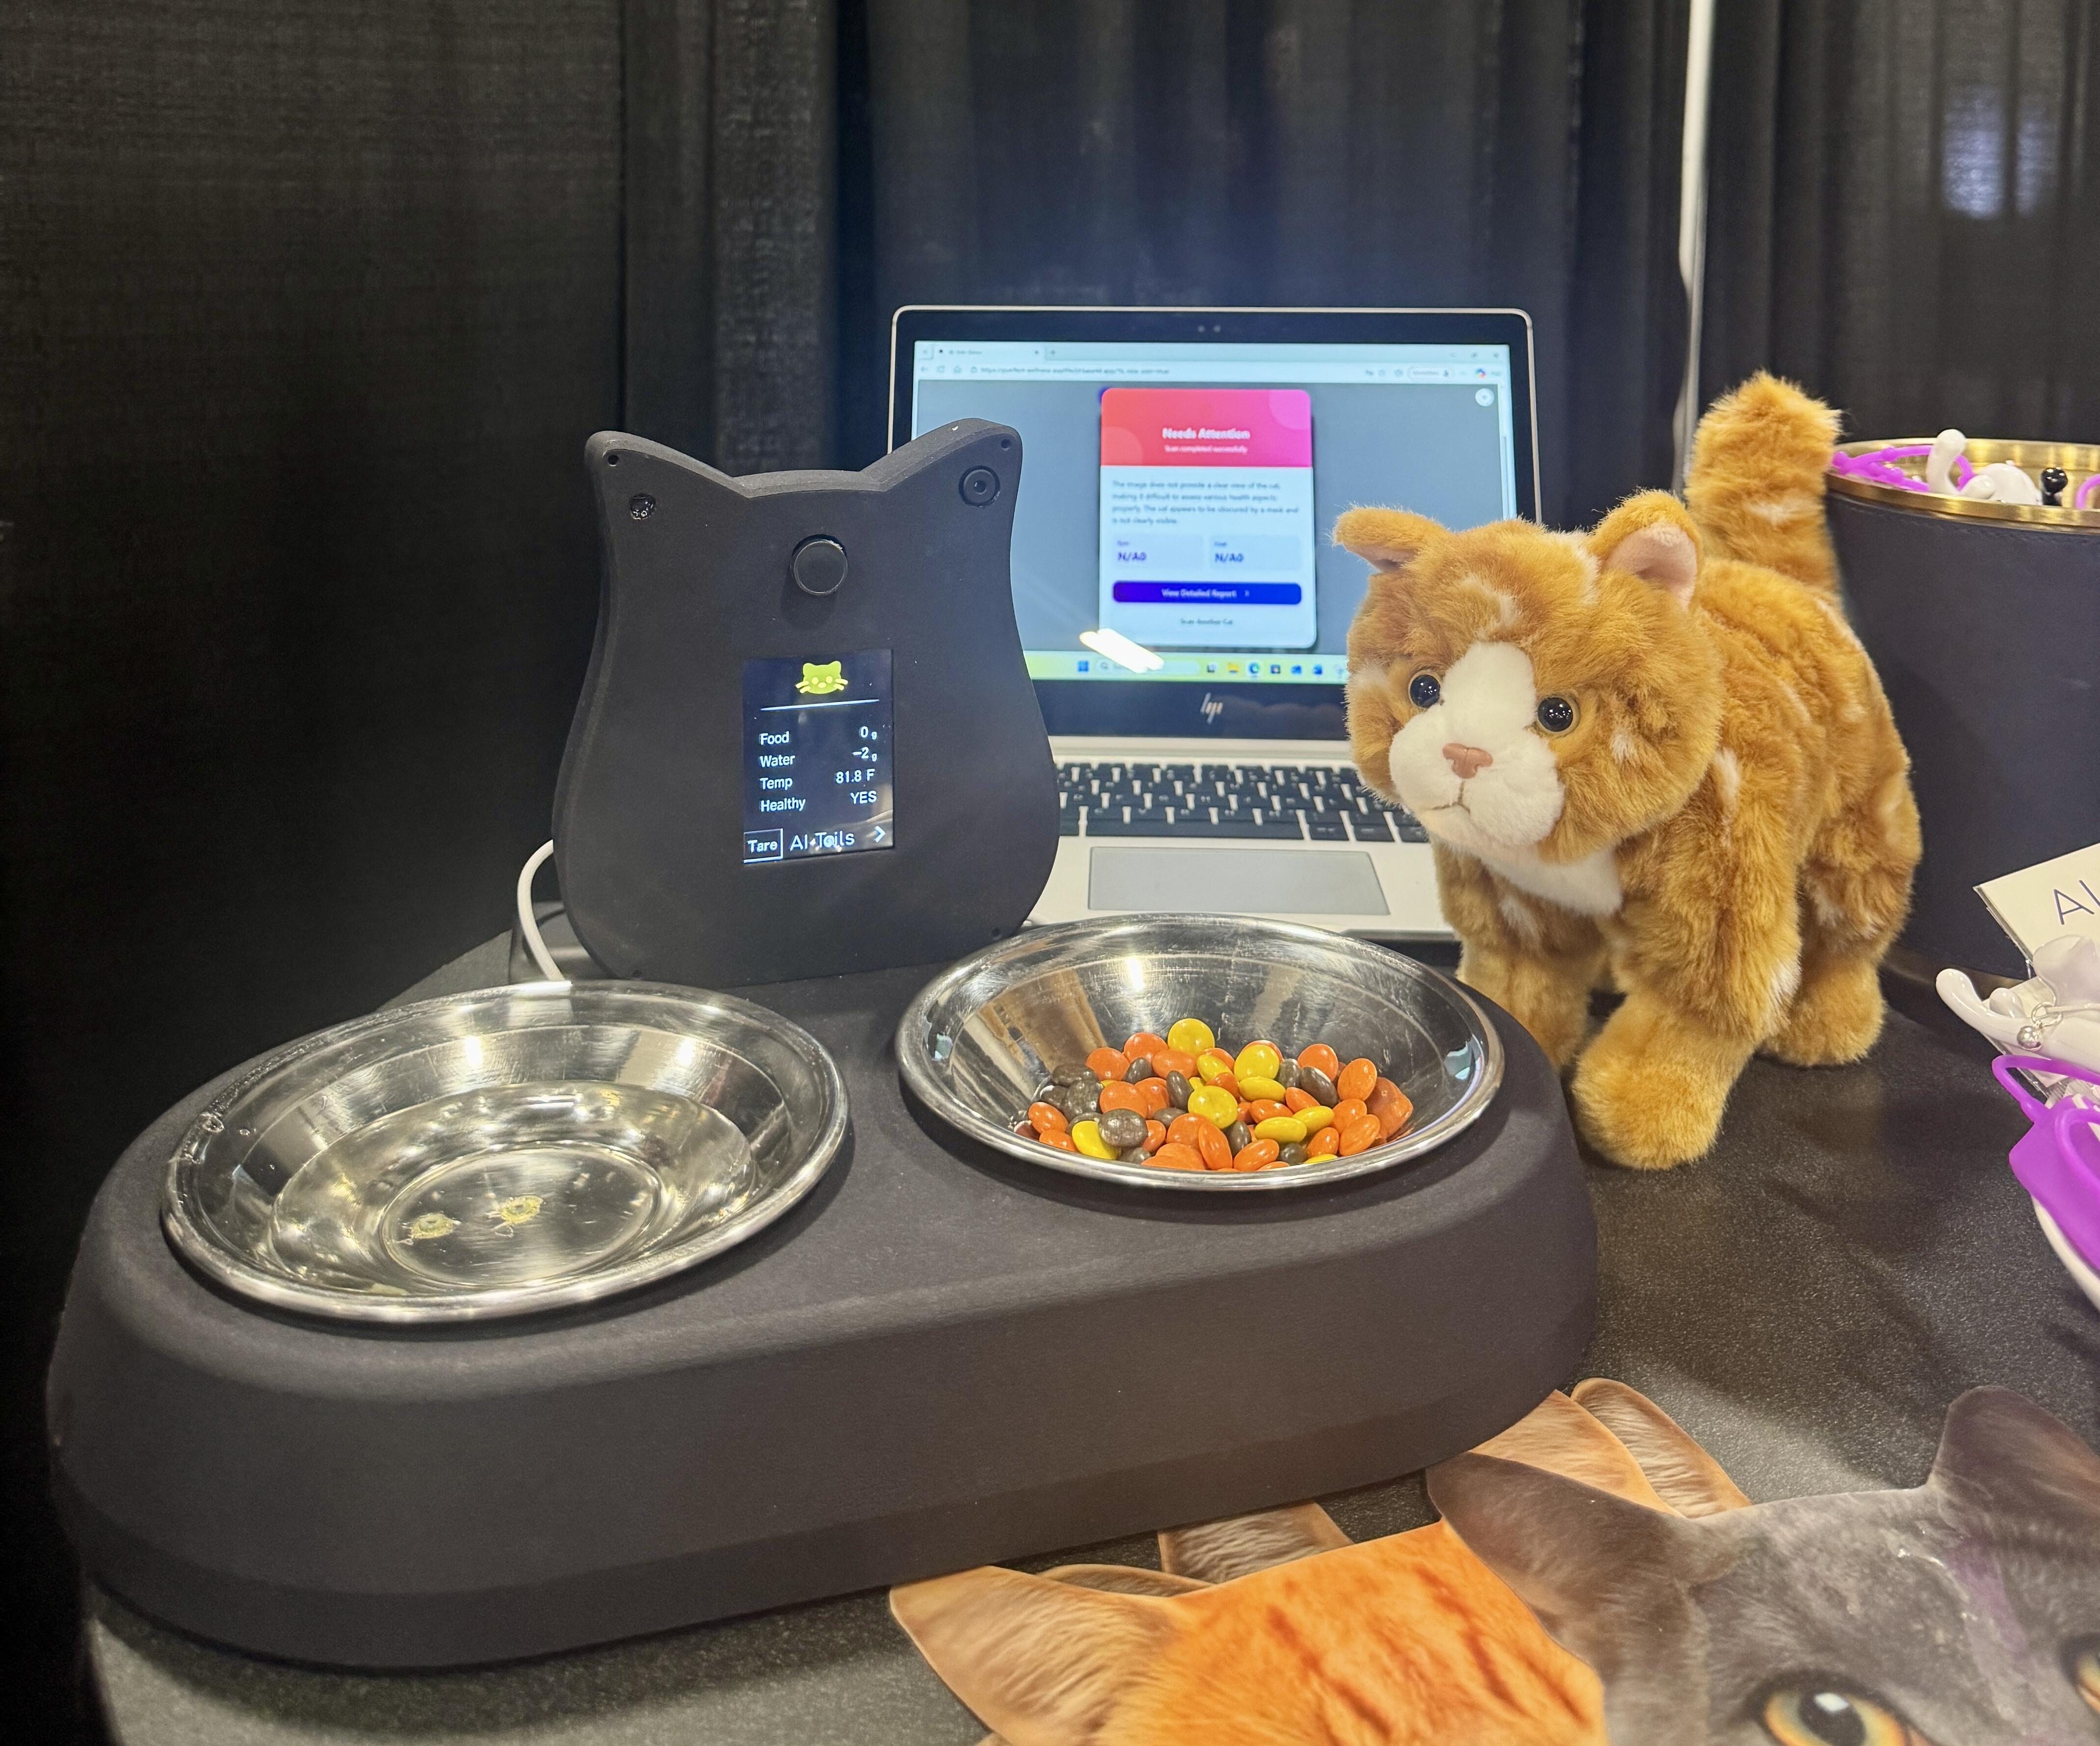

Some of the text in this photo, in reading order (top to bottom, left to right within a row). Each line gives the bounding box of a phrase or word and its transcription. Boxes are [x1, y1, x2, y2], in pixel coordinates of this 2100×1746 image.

[1162, 427, 1251, 440] Needs Attention
[1161, 589, 1237, 600] View Detailed Report
[760, 731, 790, 745] Food
[760, 755, 795, 768] Water
[760, 768, 875, 791] Temp 81.8 F
[760, 790, 877, 812] Healthy YES
[746, 839, 778, 853] Tare
